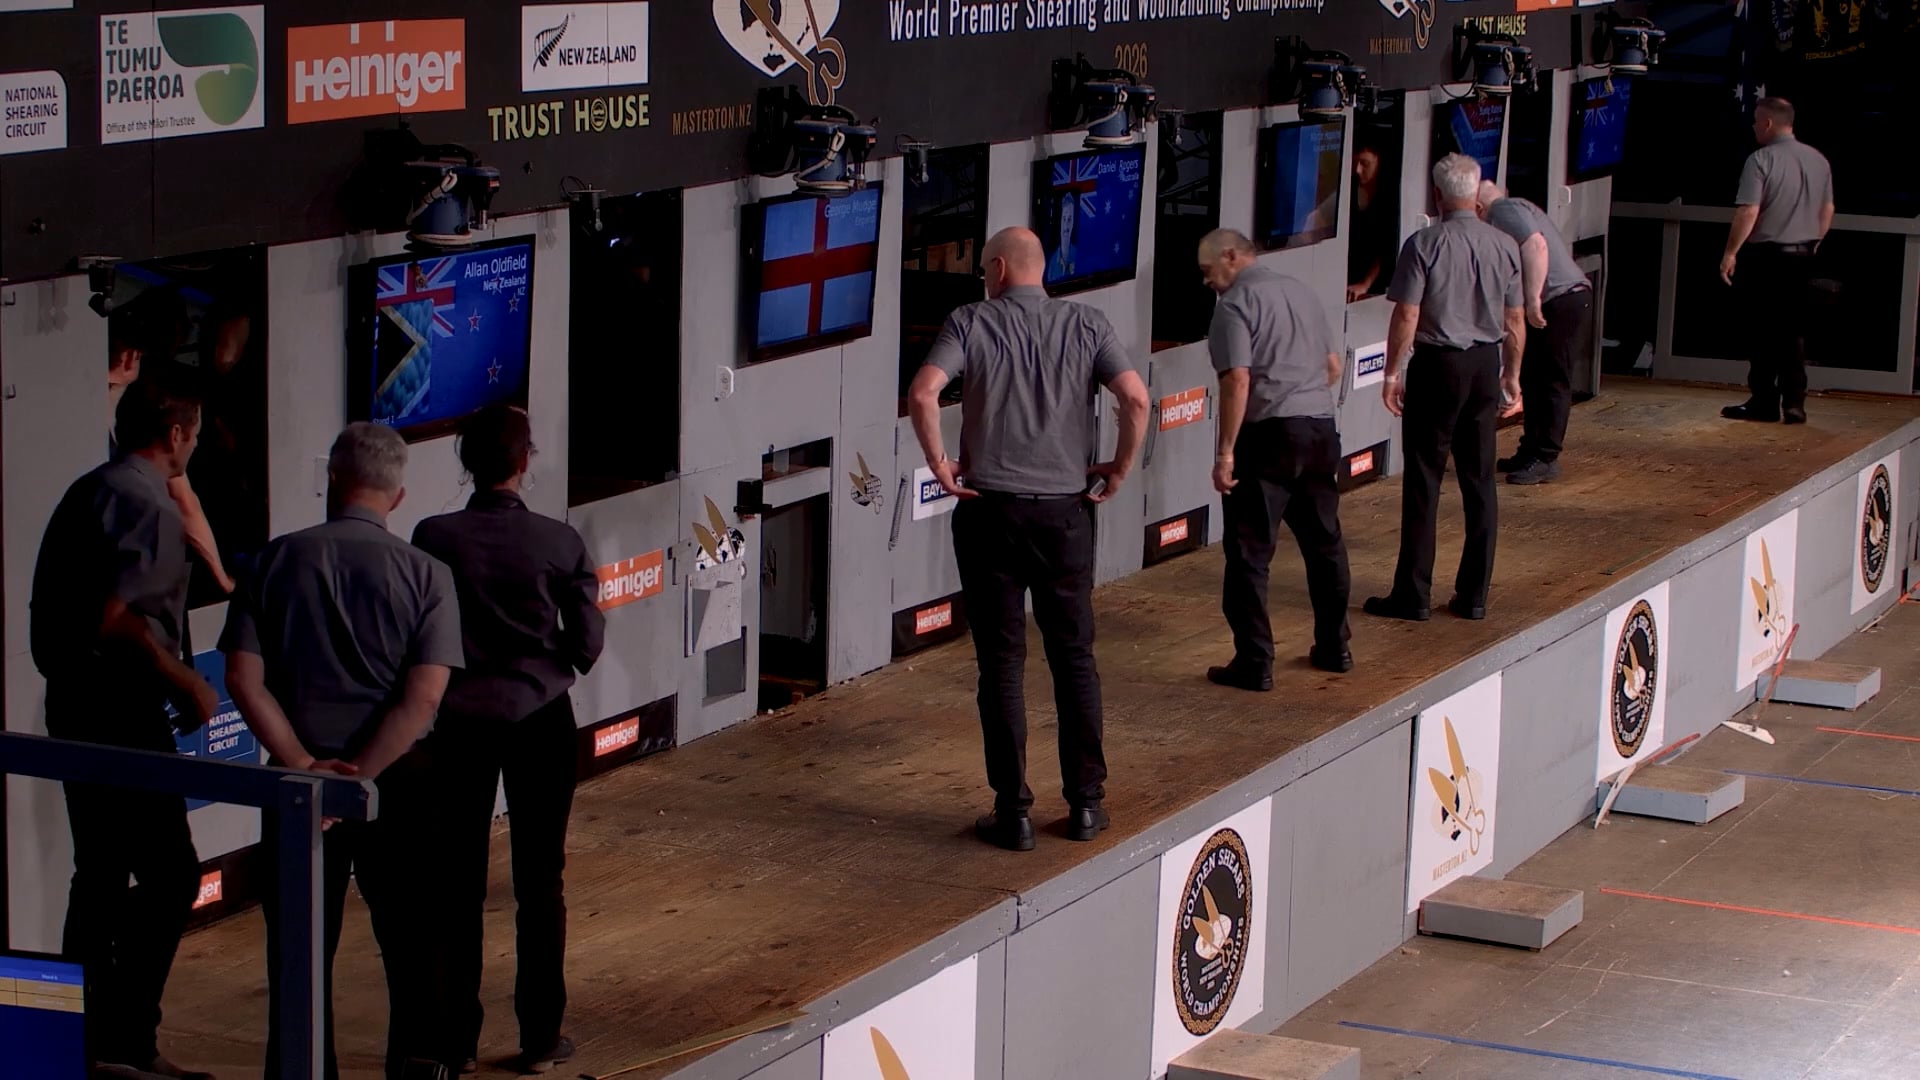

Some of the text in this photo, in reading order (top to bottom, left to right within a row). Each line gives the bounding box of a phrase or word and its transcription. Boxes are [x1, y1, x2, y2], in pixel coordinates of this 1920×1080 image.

[105, 20, 128, 45] TE
[888, 0, 940, 41] World
[949, 0, 1018, 36] Premier
[1025, 0, 1097, 32] Shearing
[1103, 0, 1130, 22] and
[1497, 15, 1527, 36] HOUSE
[105, 46, 162, 74] TUMU
[294, 21, 463, 107] Heiniger
[559, 44, 637, 66] NEW ZEALAND
[1114, 42, 1148, 78] 2026
[5, 85, 58, 102] NATIONAL
[106, 74, 185, 105] PAEROA
[5, 103, 58, 120] SHEARING
[488, 94, 650, 143] TRUST HOUSE
[672, 103, 752, 137] MASTERTON.NZ
[5, 121, 47, 138] CIRCUIT
[106, 122, 126, 134] Office
[136, 120, 147, 131] the
[170, 116, 196, 128] Trustee
[1098, 160, 1117, 174] Daniel
[464, 253, 527, 279] Allan Oldfield
[483, 273, 526, 291] New Zealand
[1162, 391, 1204, 425] Heiniger
[916, 608, 950, 630] Heiniger
[208, 735, 239, 754] CIRCUIT
[595, 723, 638, 749] Heiniger
[1183, 848, 1245, 930] GOLDEN SHEARS
[1179, 917, 1245, 1016] WORLD CHAMPIONSHIPS
